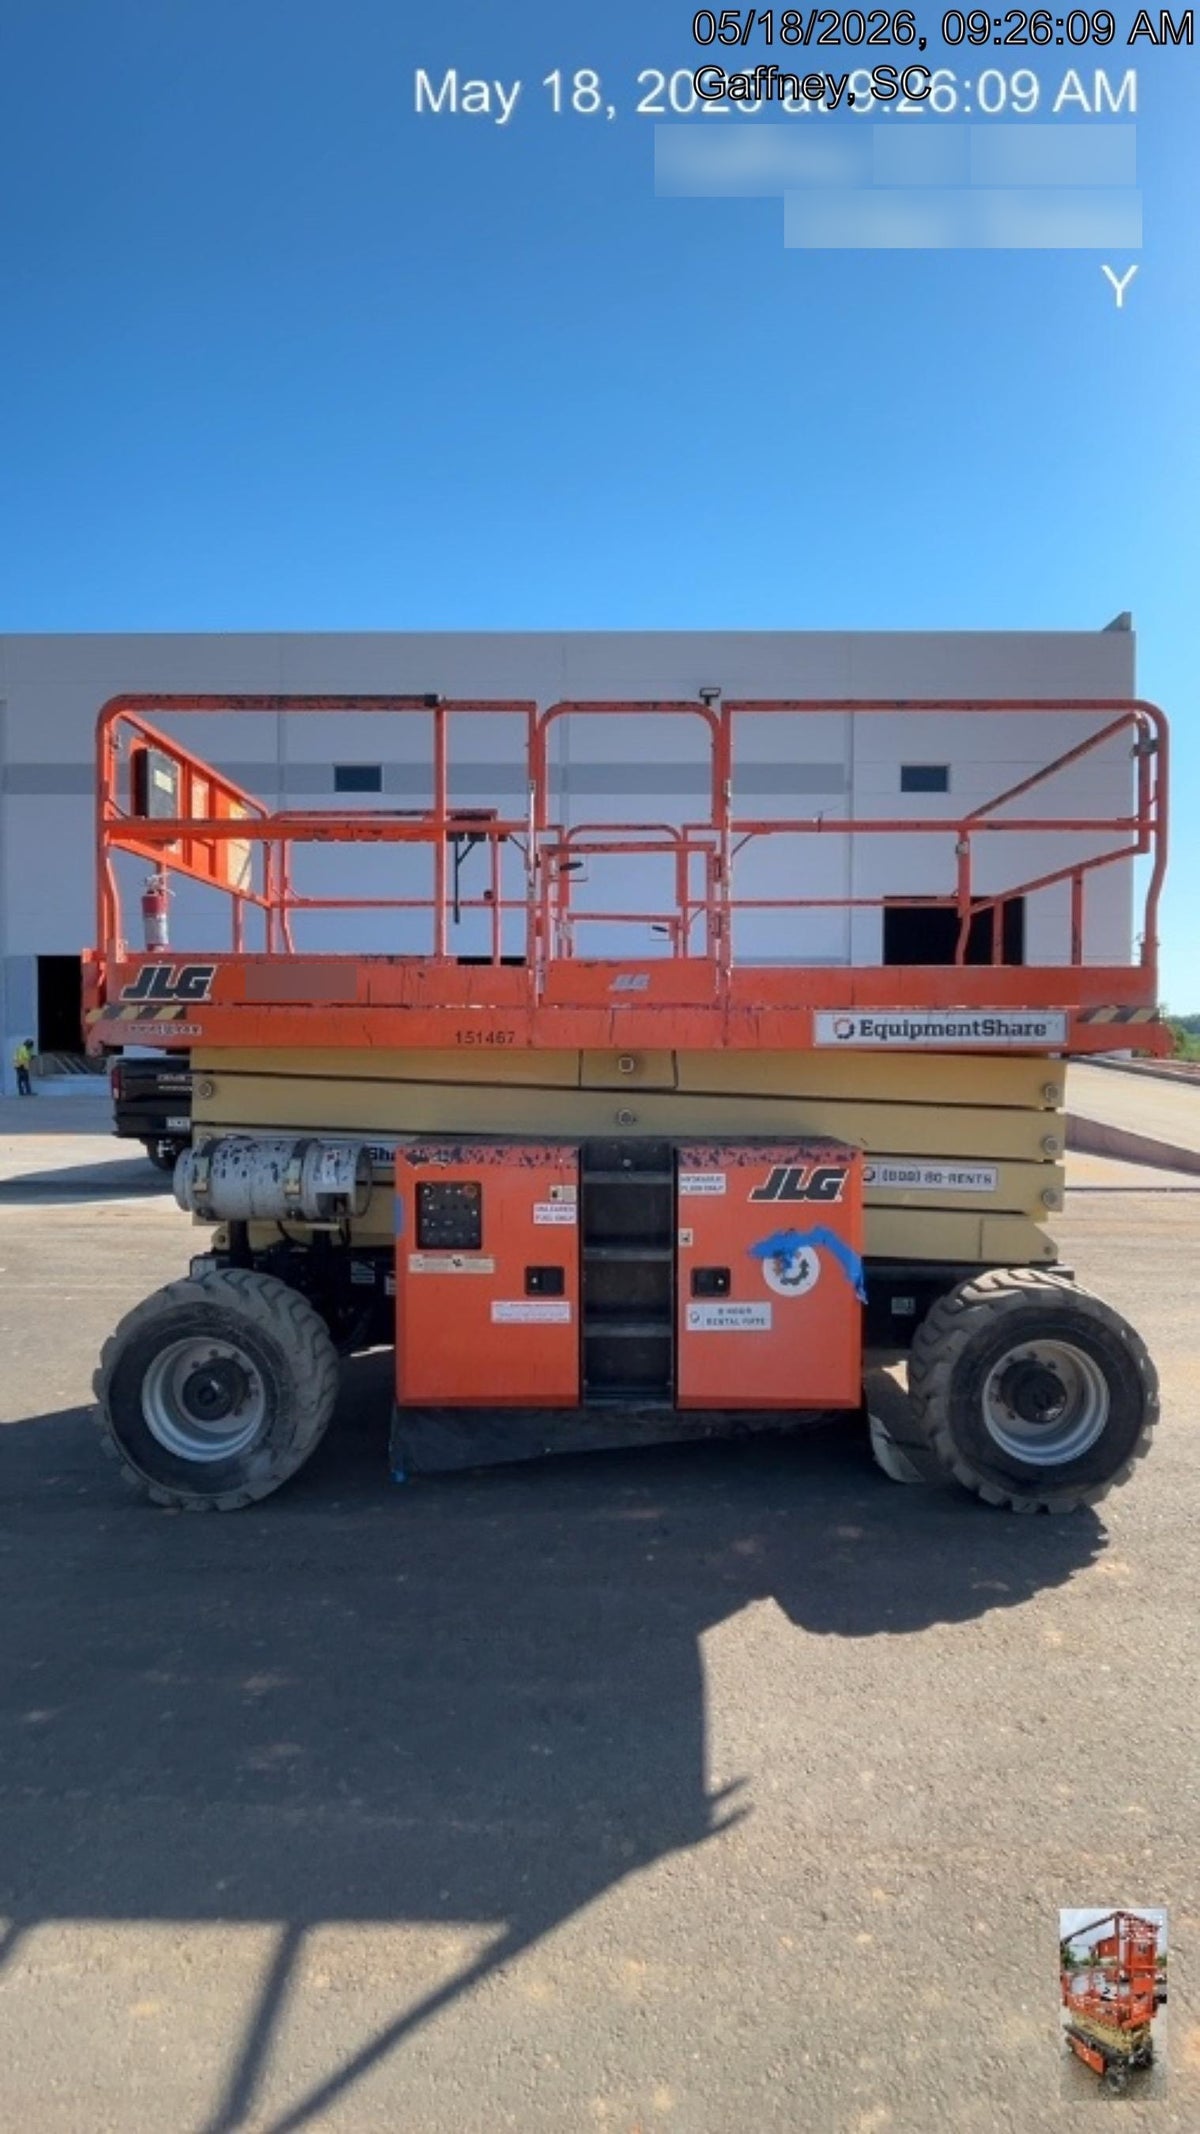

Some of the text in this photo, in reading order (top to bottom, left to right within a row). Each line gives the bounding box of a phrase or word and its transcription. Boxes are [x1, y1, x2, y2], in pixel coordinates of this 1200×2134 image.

[118, 964, 218, 1002] JLG
[455, 1030, 515, 1045] 151467
[859, 1018, 1048, 1041] EquipmentShare
[747, 1164, 849, 1203] JLG
